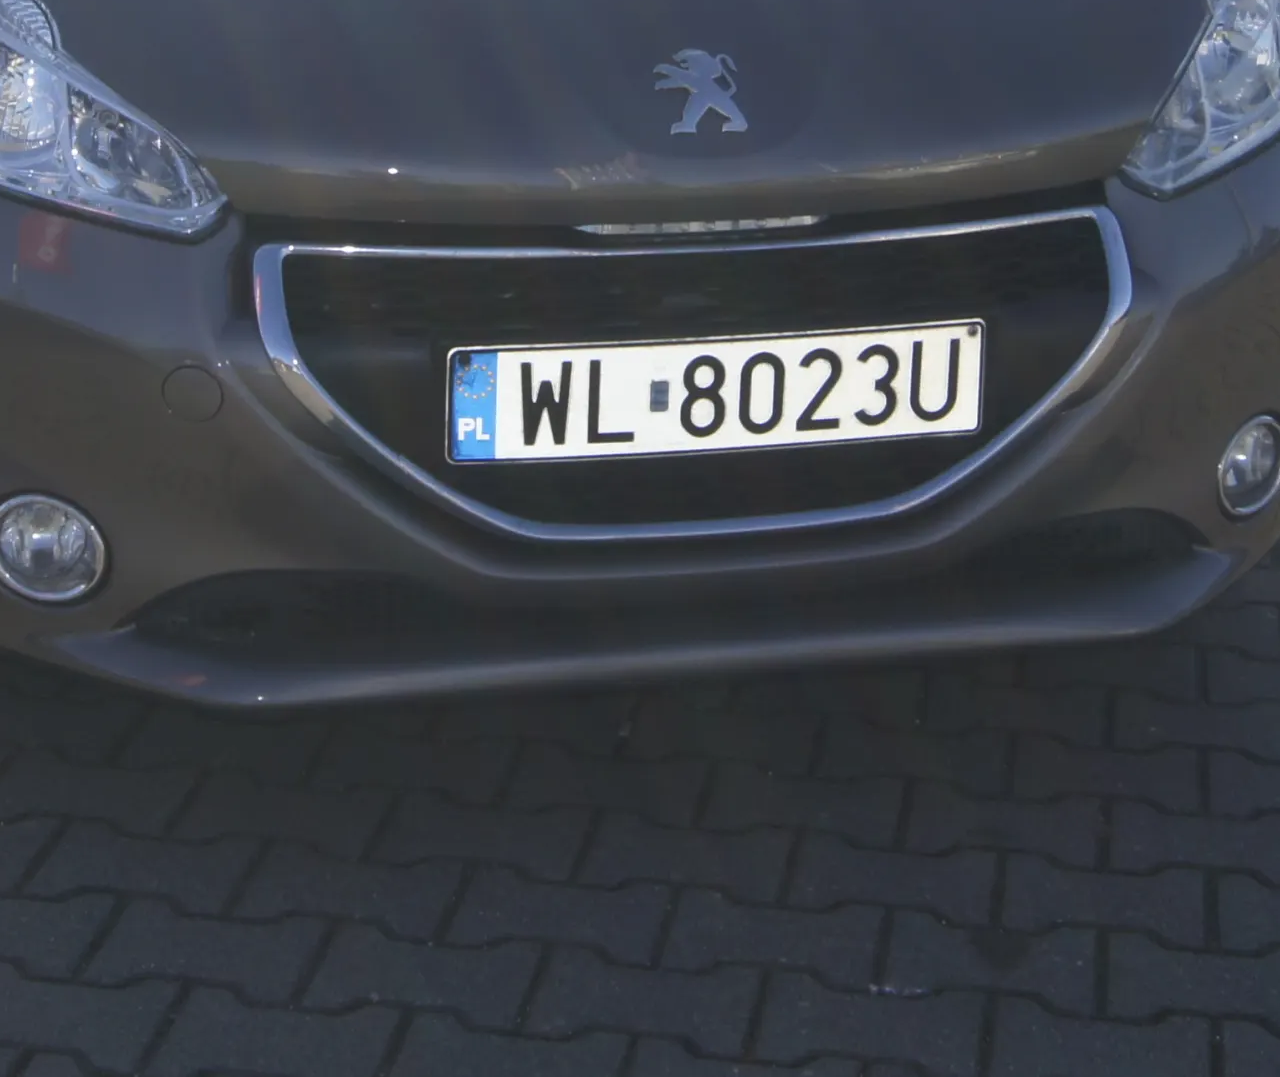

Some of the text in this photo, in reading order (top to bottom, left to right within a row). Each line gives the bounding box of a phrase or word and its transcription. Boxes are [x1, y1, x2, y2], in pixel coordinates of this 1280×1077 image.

[520, 337, 961, 446] WL 8023U
[457, 417, 490, 442] PL
